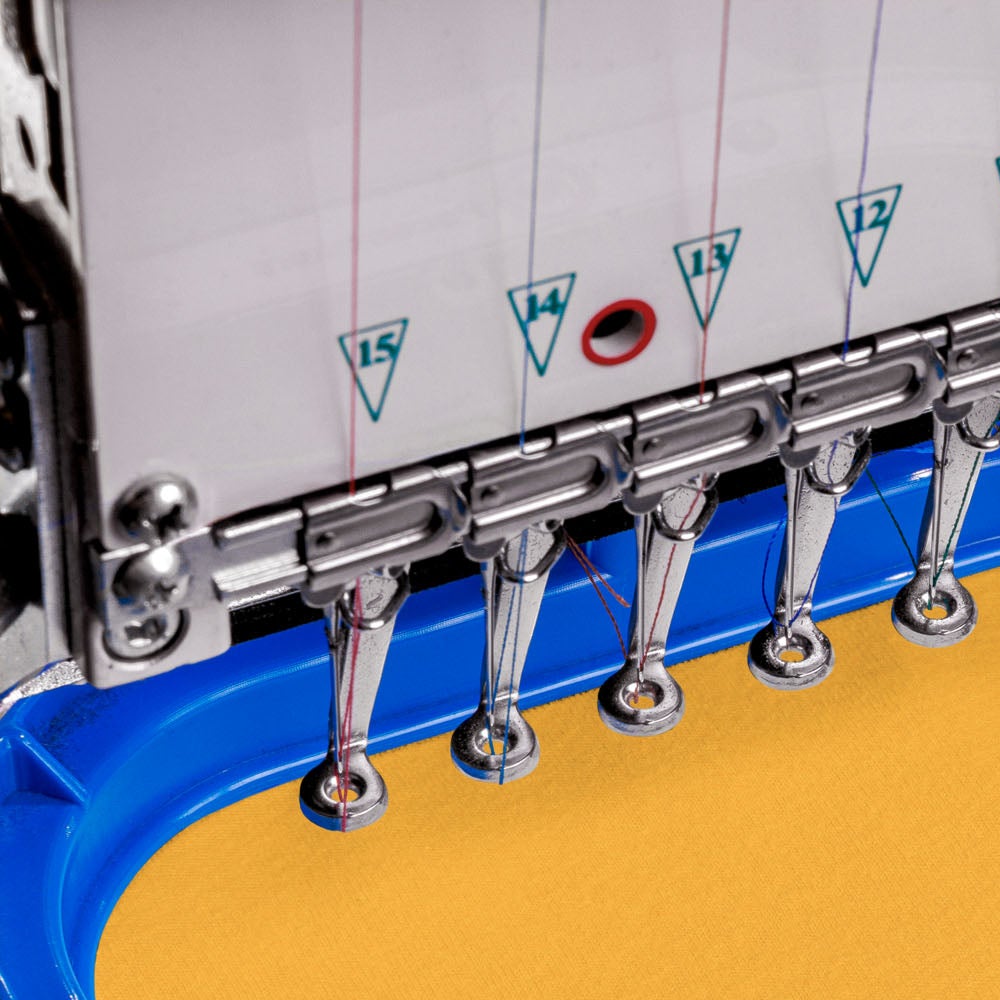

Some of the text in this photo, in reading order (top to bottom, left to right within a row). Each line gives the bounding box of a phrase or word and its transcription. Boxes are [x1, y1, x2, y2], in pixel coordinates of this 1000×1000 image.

[851, 199, 890, 235] 12
[690, 242, 730, 279] 13
[526, 287, 567, 323] 14
[358, 331, 399, 369] 15
